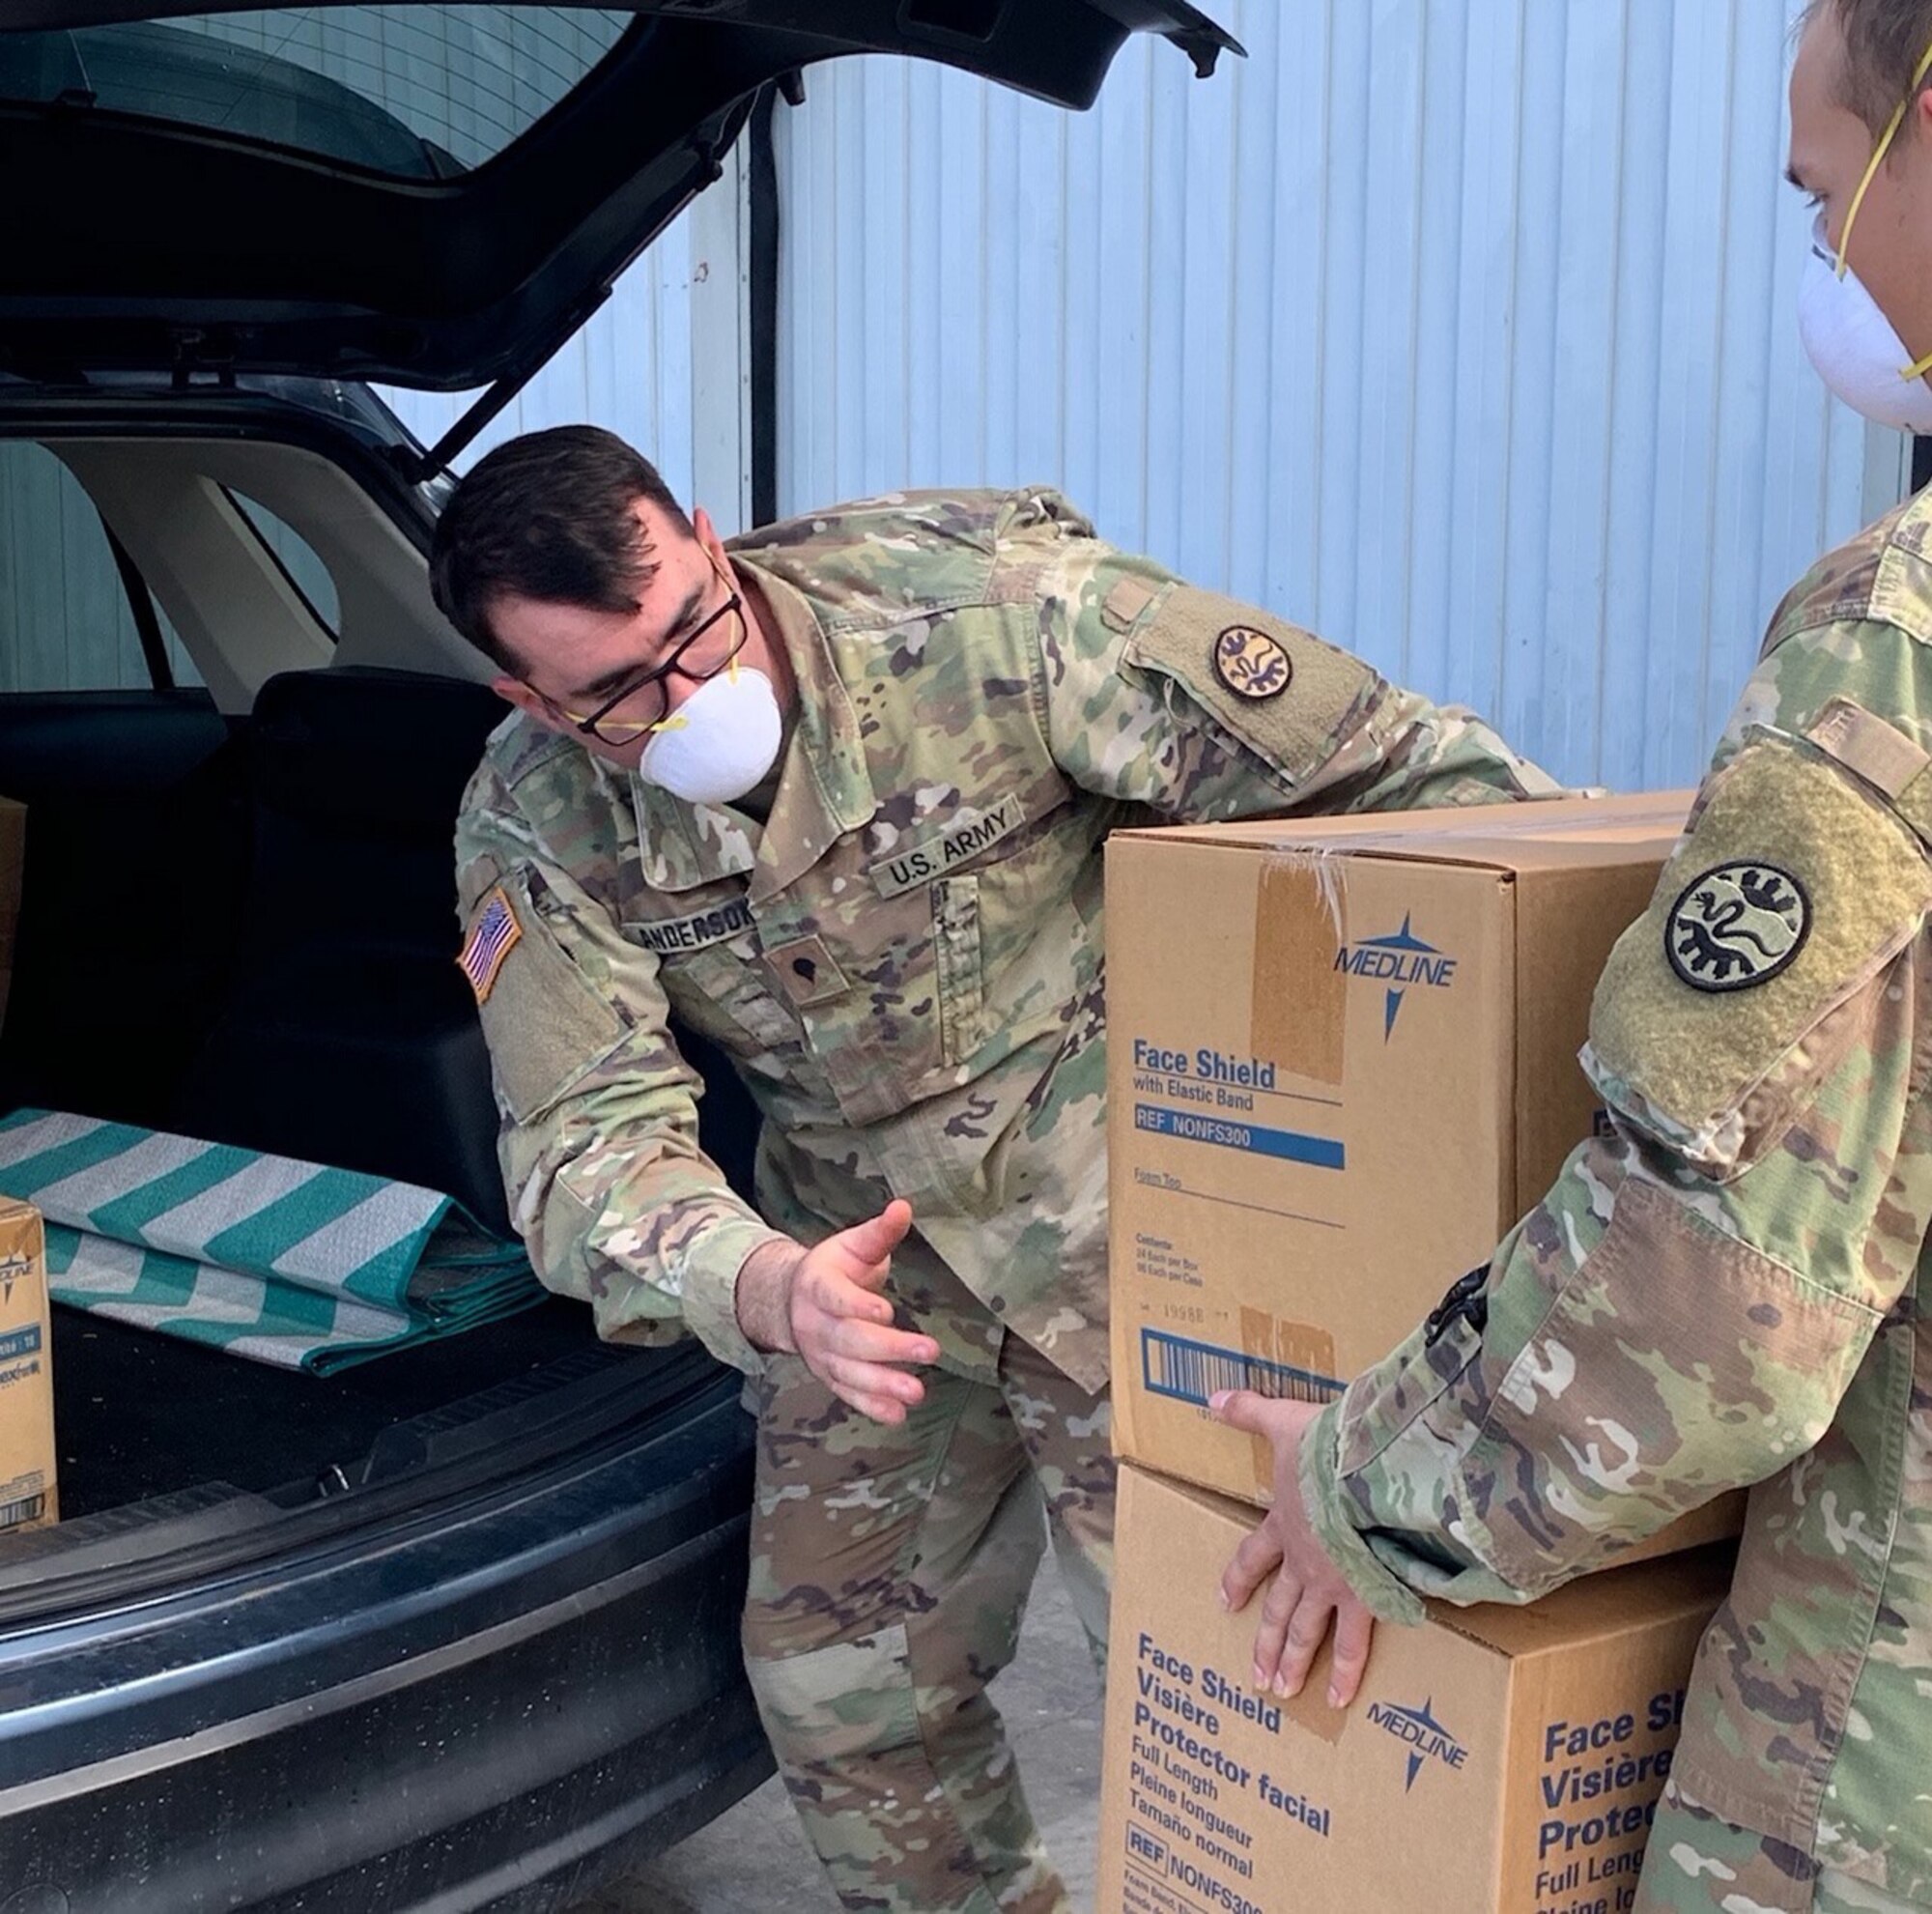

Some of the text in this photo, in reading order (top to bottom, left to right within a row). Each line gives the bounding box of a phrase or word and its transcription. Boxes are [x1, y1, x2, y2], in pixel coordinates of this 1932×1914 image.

[889, 806, 1010, 886] U.S. ARMY
[1333, 946, 1459, 986] MEDLINE
[1133, 1074, 1254, 1111] with Elastic Band
[1134, 1039, 1276, 1089] Face Shield
[1136, 1107, 1251, 1147] REF NONFS300
[1137, 1667, 1220, 1735] Visière
[1138, 1632, 1282, 1734] Face Shield
[1366, 1701, 1469, 1770] MEDLINE
[1545, 1714, 1634, 1762] Face
[1131, 1734, 1219, 1801] Full Length
[1134, 1700, 1331, 1838] Protector facial
[1541, 1749, 1673, 1809] Visière
[1128, 1787, 1254, 1879] Tamaño normal
[1129, 1760, 1254, 1849] Pleine longueur
[1130, 1831, 1165, 1864] REF
[1535, 1861, 1579, 1900] Full
